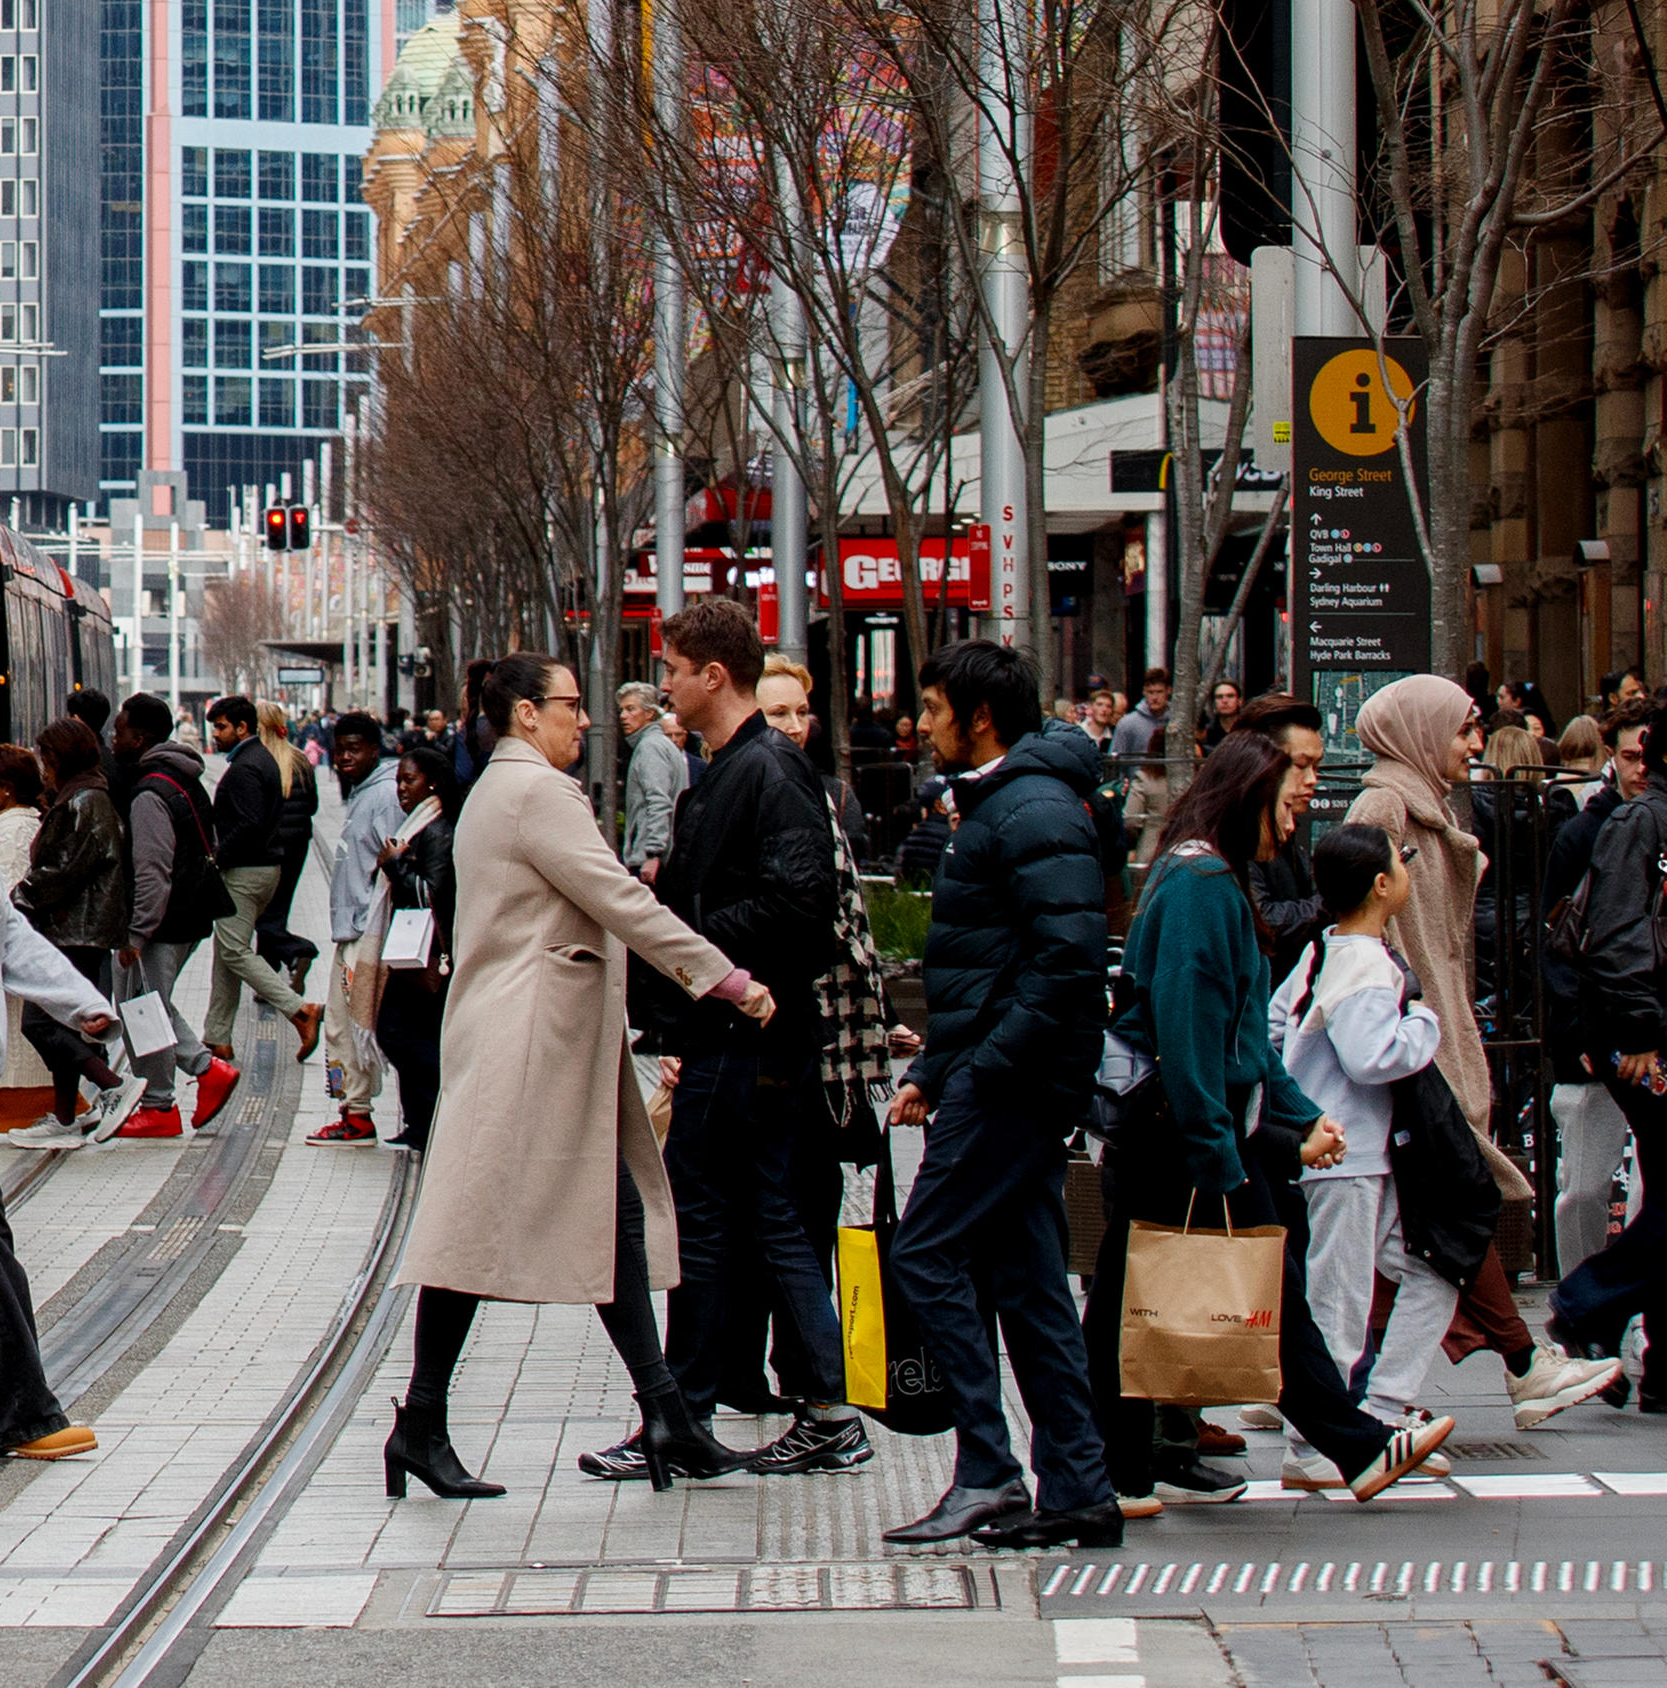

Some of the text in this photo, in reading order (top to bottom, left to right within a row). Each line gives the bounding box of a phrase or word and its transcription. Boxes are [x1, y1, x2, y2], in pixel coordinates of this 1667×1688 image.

[1309, 468, 1392, 484] George Street
[1309, 486, 1364, 499] King Street
[1310, 529, 1329, 540] QVB
[1310, 543, 1351, 552] Town Hall
[1308, 554, 1342, 566] Gadigal
[1047, 561, 1087, 572] SONY
[1310, 583, 1377, 595] Darling Harbour
[1310, 596, 1383, 608] Sydney Aquarium
[1310, 636, 1382, 649] Macquarie Street
[1310, 650, 1391, 662] Hyde Park Barracks
[1129, 1308, 1158, 1318] WITH
[1211, 1310, 1273, 1328] LOVE H&M
